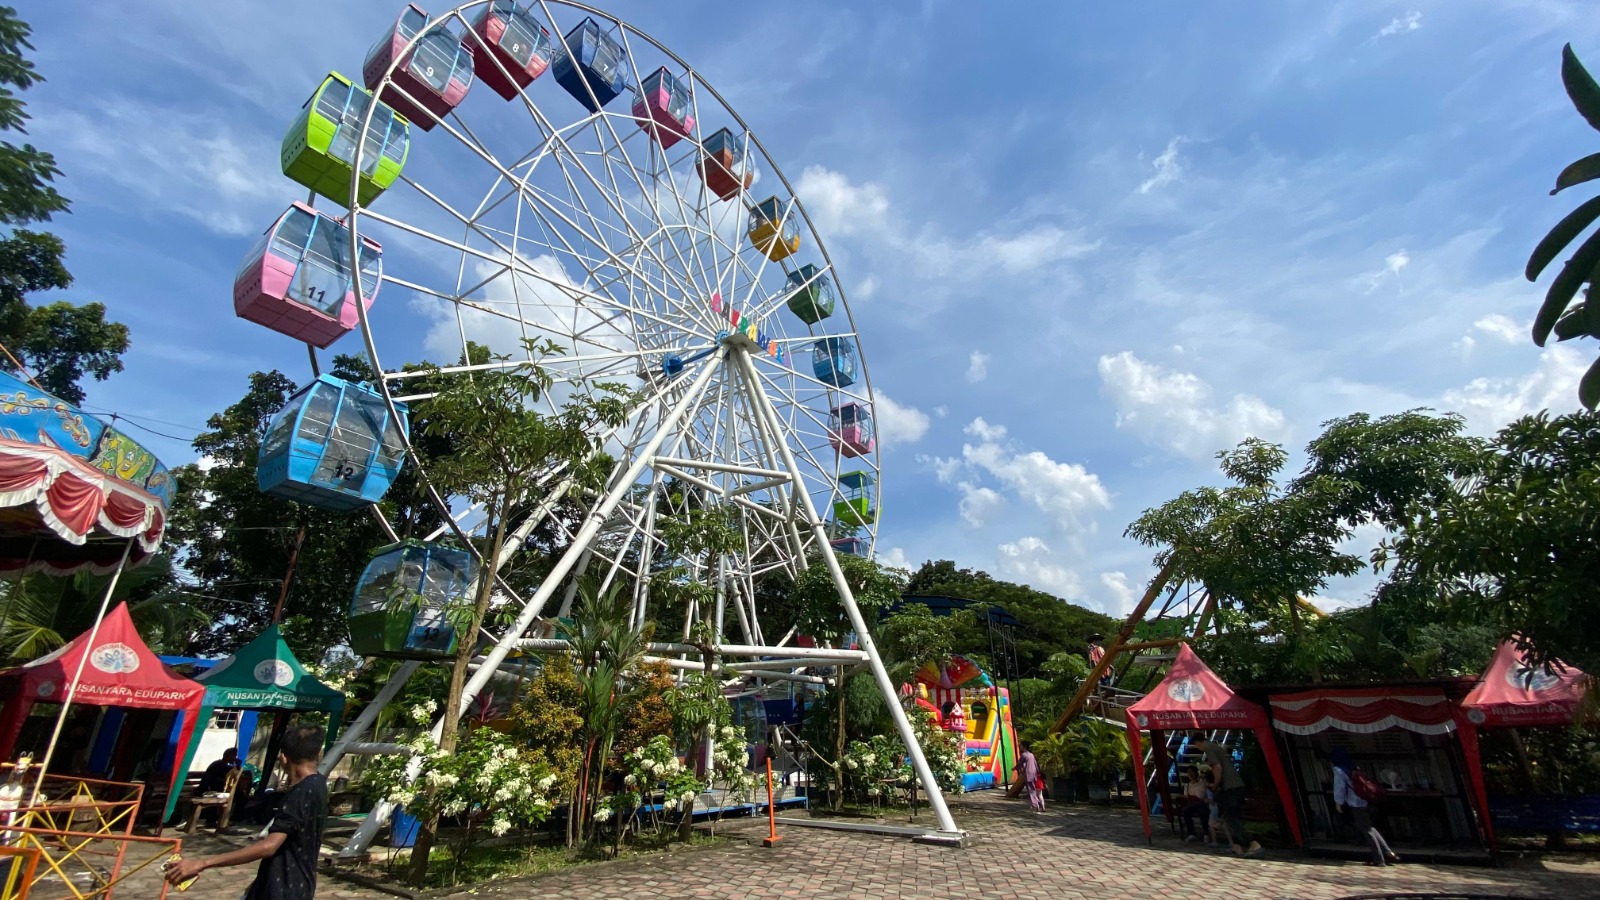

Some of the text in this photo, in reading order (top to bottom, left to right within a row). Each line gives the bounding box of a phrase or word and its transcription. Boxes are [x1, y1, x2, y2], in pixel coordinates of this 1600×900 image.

[512, 43, 520, 52] 8
[425, 66, 434, 77] 9
[603, 63, 609, 72] 7
[308, 286, 326, 303] 11
[335, 464, 354, 481] 12
[424, 627, 439, 639] 13
[64, 682, 133, 697] NUSANTARA
[134, 689, 186, 700] EDUPARK
[227, 691, 323, 704] NUSANTARA EDUPARK
[1152, 711, 1248, 720] NUSANTARA EDUPARK
[1492, 704, 1567, 716] NUSANTARA
